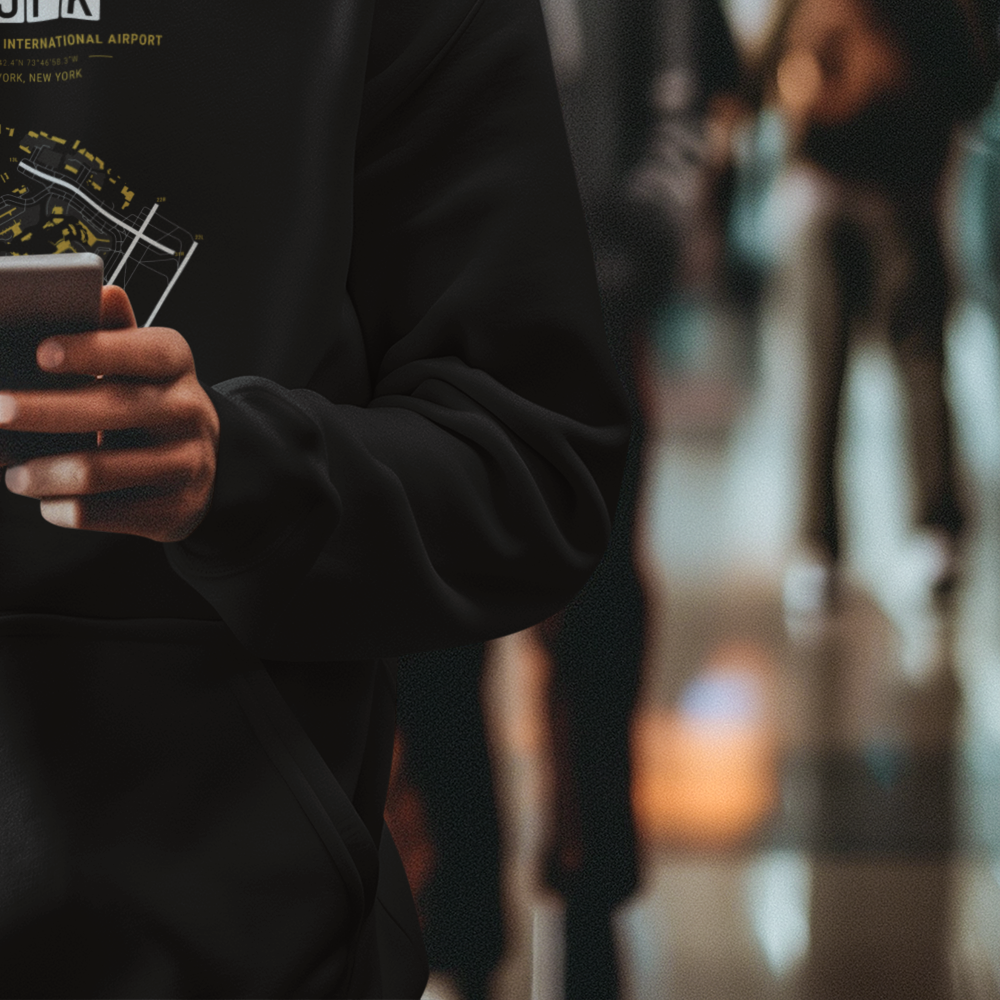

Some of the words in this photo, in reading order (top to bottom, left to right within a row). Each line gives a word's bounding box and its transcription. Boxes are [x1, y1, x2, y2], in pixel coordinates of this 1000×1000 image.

[3, 34, 103, 50] INTERNATIONAL
[107, 33, 163, 46] AIRPORT
[29, 73, 52, 83] NEW
[55, 68, 83, 82] YORK
